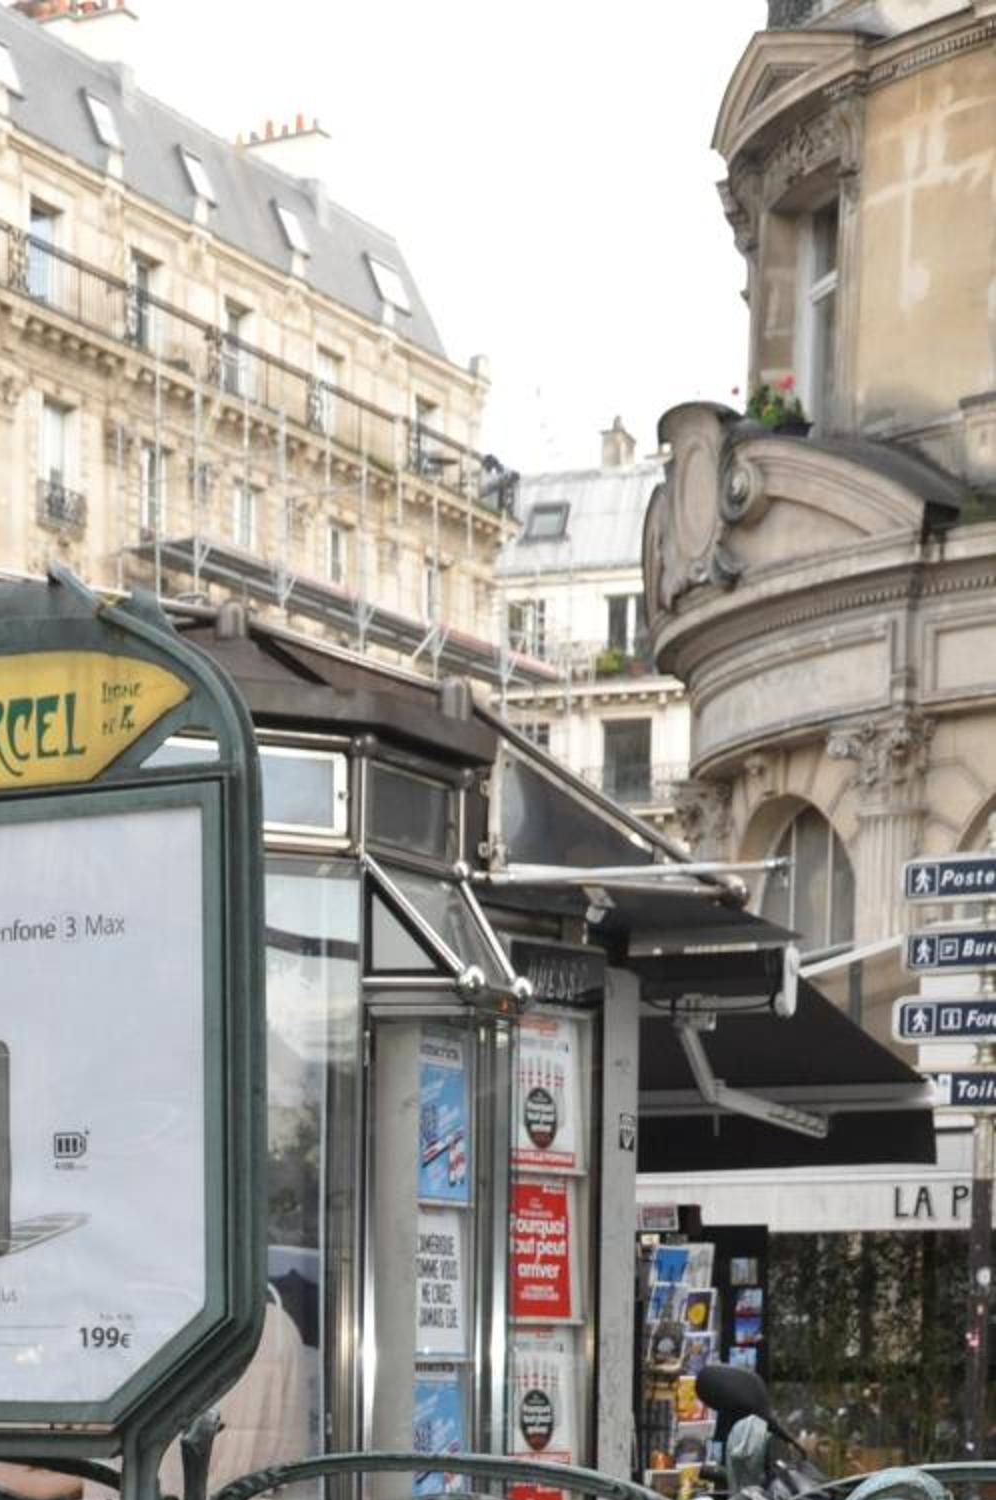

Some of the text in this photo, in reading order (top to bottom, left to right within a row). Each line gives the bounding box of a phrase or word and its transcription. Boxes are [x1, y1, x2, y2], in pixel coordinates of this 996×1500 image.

[939, 867, 996, 887] Poste
[64, 915, 77, 939] 3
[84, 913, 126, 938] Max
[894, 1185, 933, 1218] LA
[78, 1326, 133, 1349] 199€
